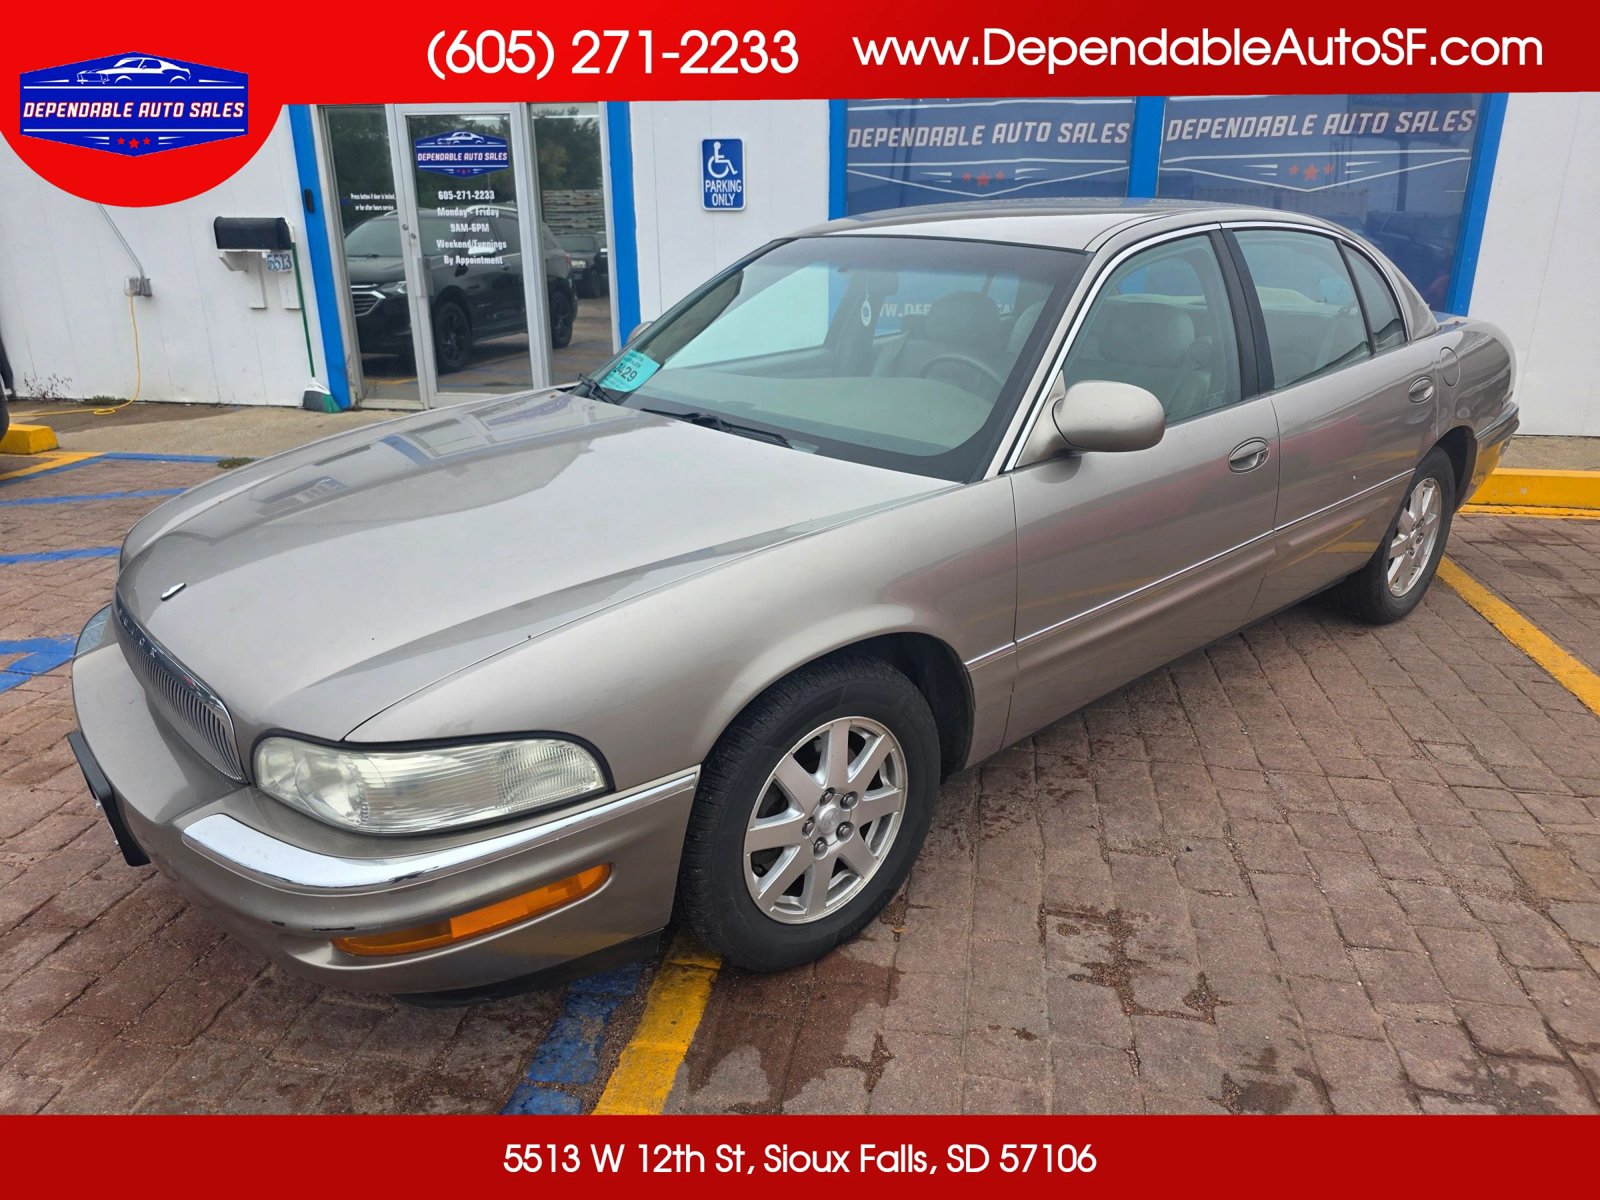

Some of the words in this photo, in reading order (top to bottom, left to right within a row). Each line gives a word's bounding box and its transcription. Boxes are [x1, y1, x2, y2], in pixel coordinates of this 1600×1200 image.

[1166, 114, 1318, 142] DEPENDABLE
[1322, 112, 1390, 135] AUTO
[1394, 109, 1477, 133] SALES
[847, 125, 986, 148] DEPENDABLE
[991, 121, 1052, 144] AUTO
[1057, 122, 1131, 144] SALES
[417, 152, 463, 162] DEPENDABLE
[463, 152, 483, 161] AUTO
[484, 152, 508, 161] SALES
[705, 179, 742, 193] PARKING
[438, 190, 495, 200] 605-271-2233
[712, 193, 736, 207] ONLY
[437, 206, 468, 218] Monday
[475, 207, 500, 218] Friday
[450, 223, 490, 232] 9AM-6PM
[266, 253, 293, 271] 5513
[443, 255, 454, 266] By
[455, 255, 504, 266] Appointment
